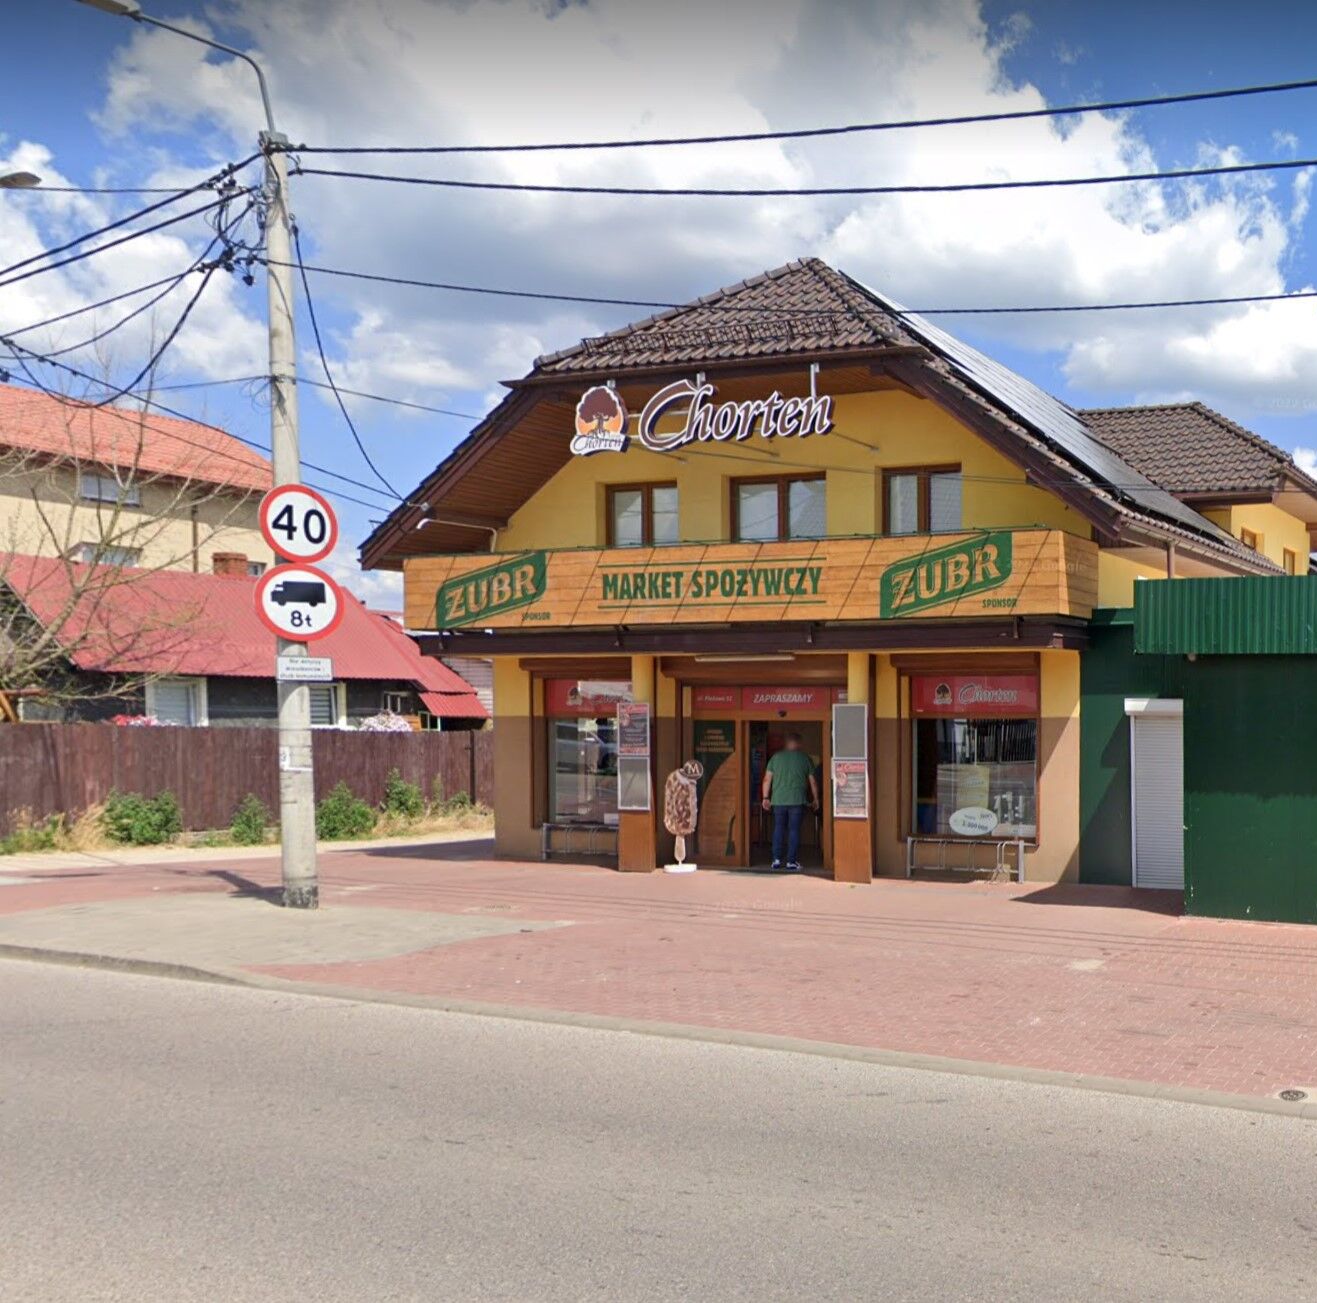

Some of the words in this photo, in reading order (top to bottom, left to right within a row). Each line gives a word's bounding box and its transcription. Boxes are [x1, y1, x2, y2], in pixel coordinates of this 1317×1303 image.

[638, 379, 832, 450] Chorten
[271, 504, 327, 544] 40
[602, 571, 684, 600] MARKET
[982, 598, 1018, 608] SPONSOR
[753, 694, 813, 704] ZAPRASZAMY
